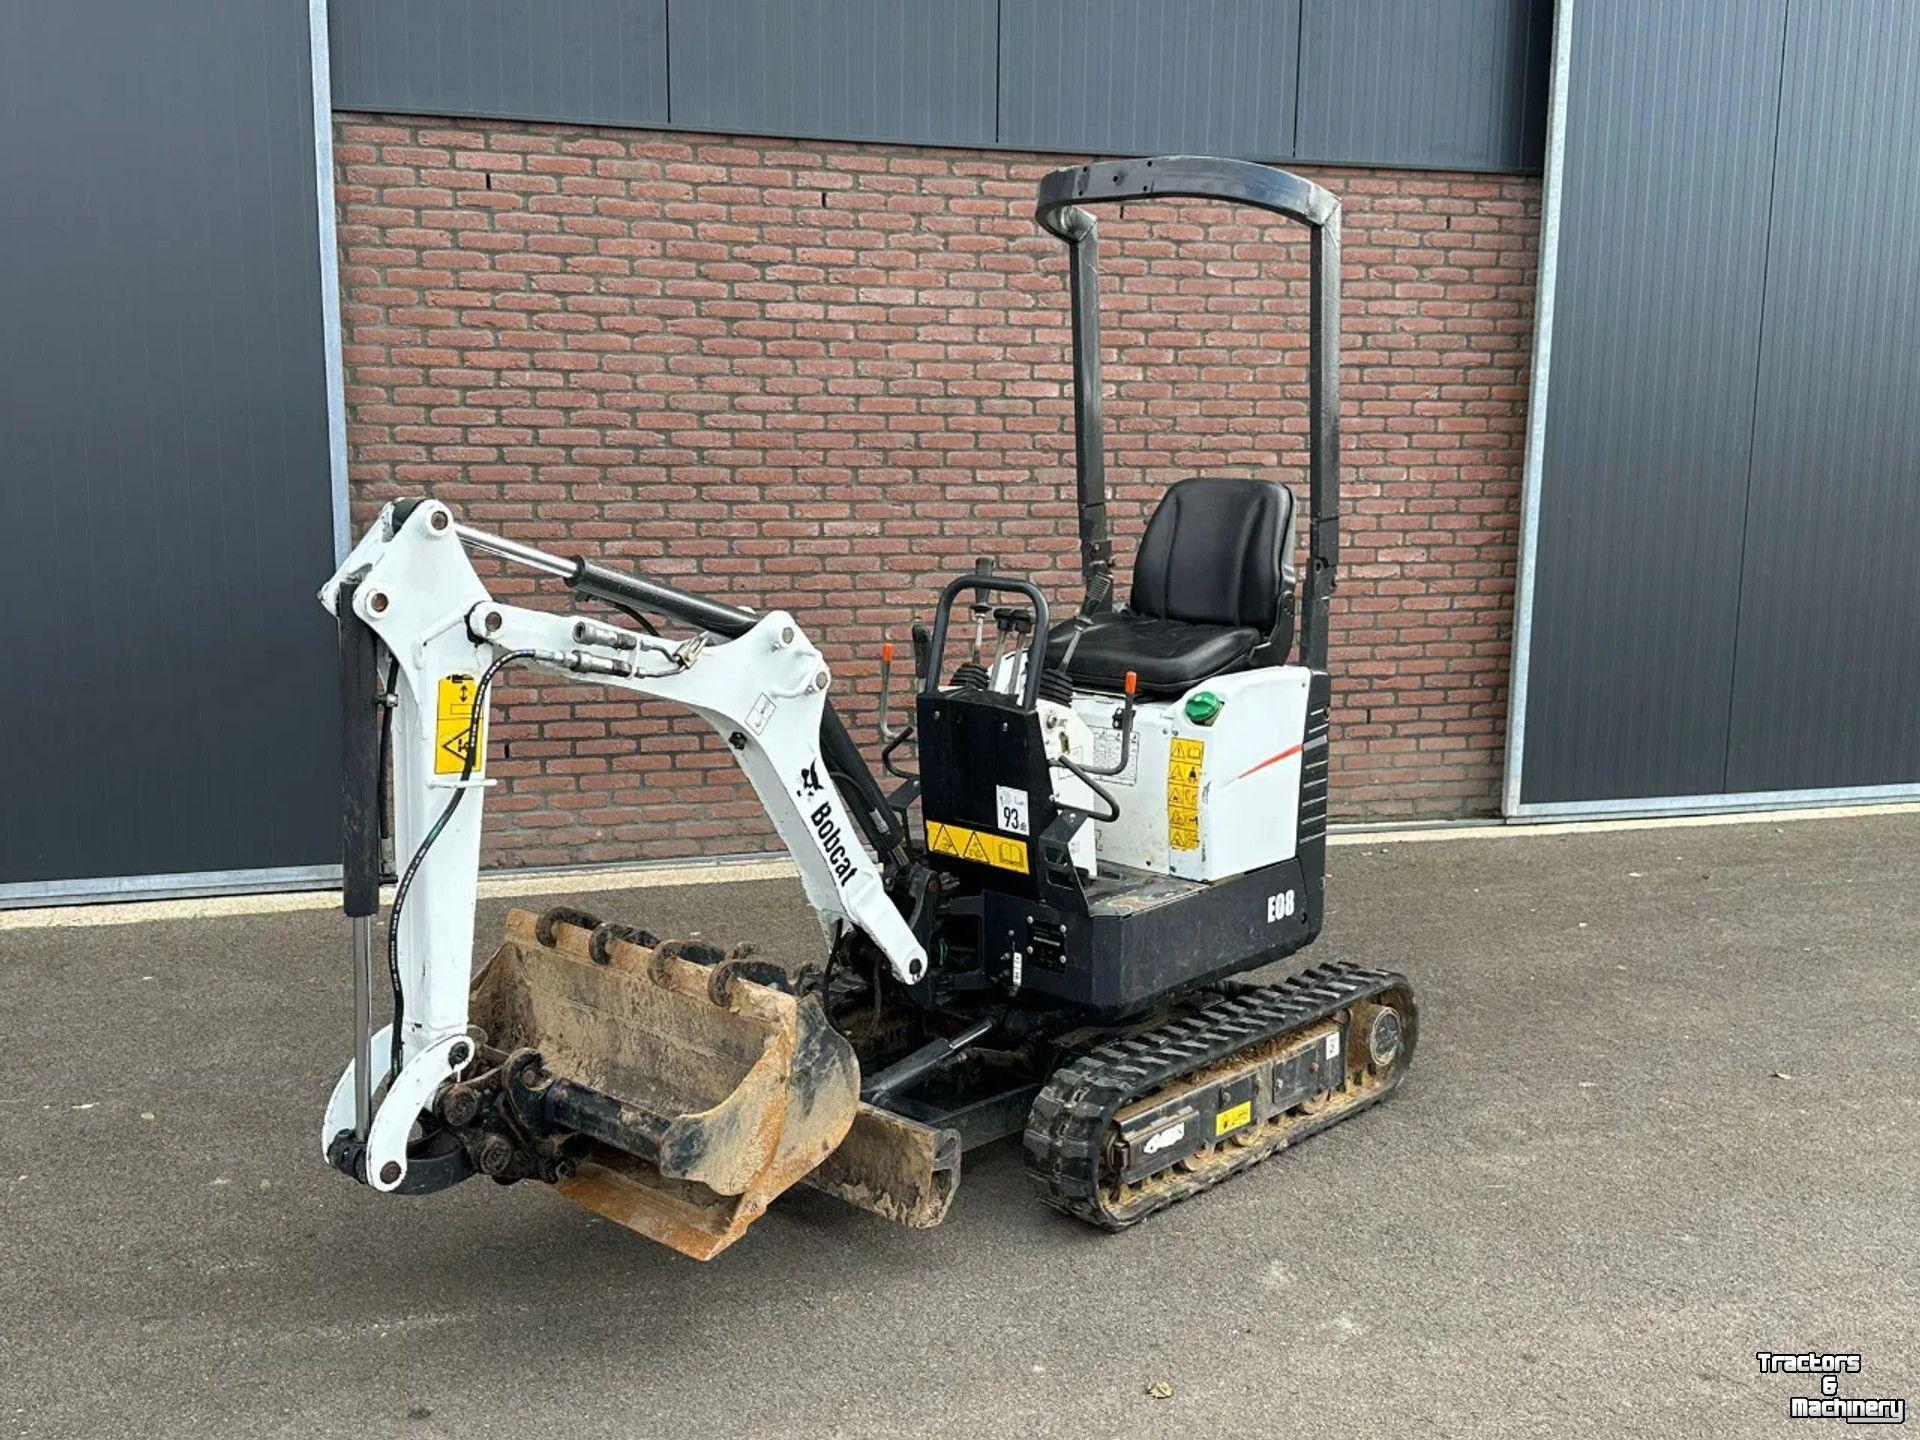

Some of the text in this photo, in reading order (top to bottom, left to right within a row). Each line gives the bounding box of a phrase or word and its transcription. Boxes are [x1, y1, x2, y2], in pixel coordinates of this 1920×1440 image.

[1003, 806, 1019, 829] 93
[811, 801, 858, 887] Bobcat
[1267, 889, 1295, 923] E08
